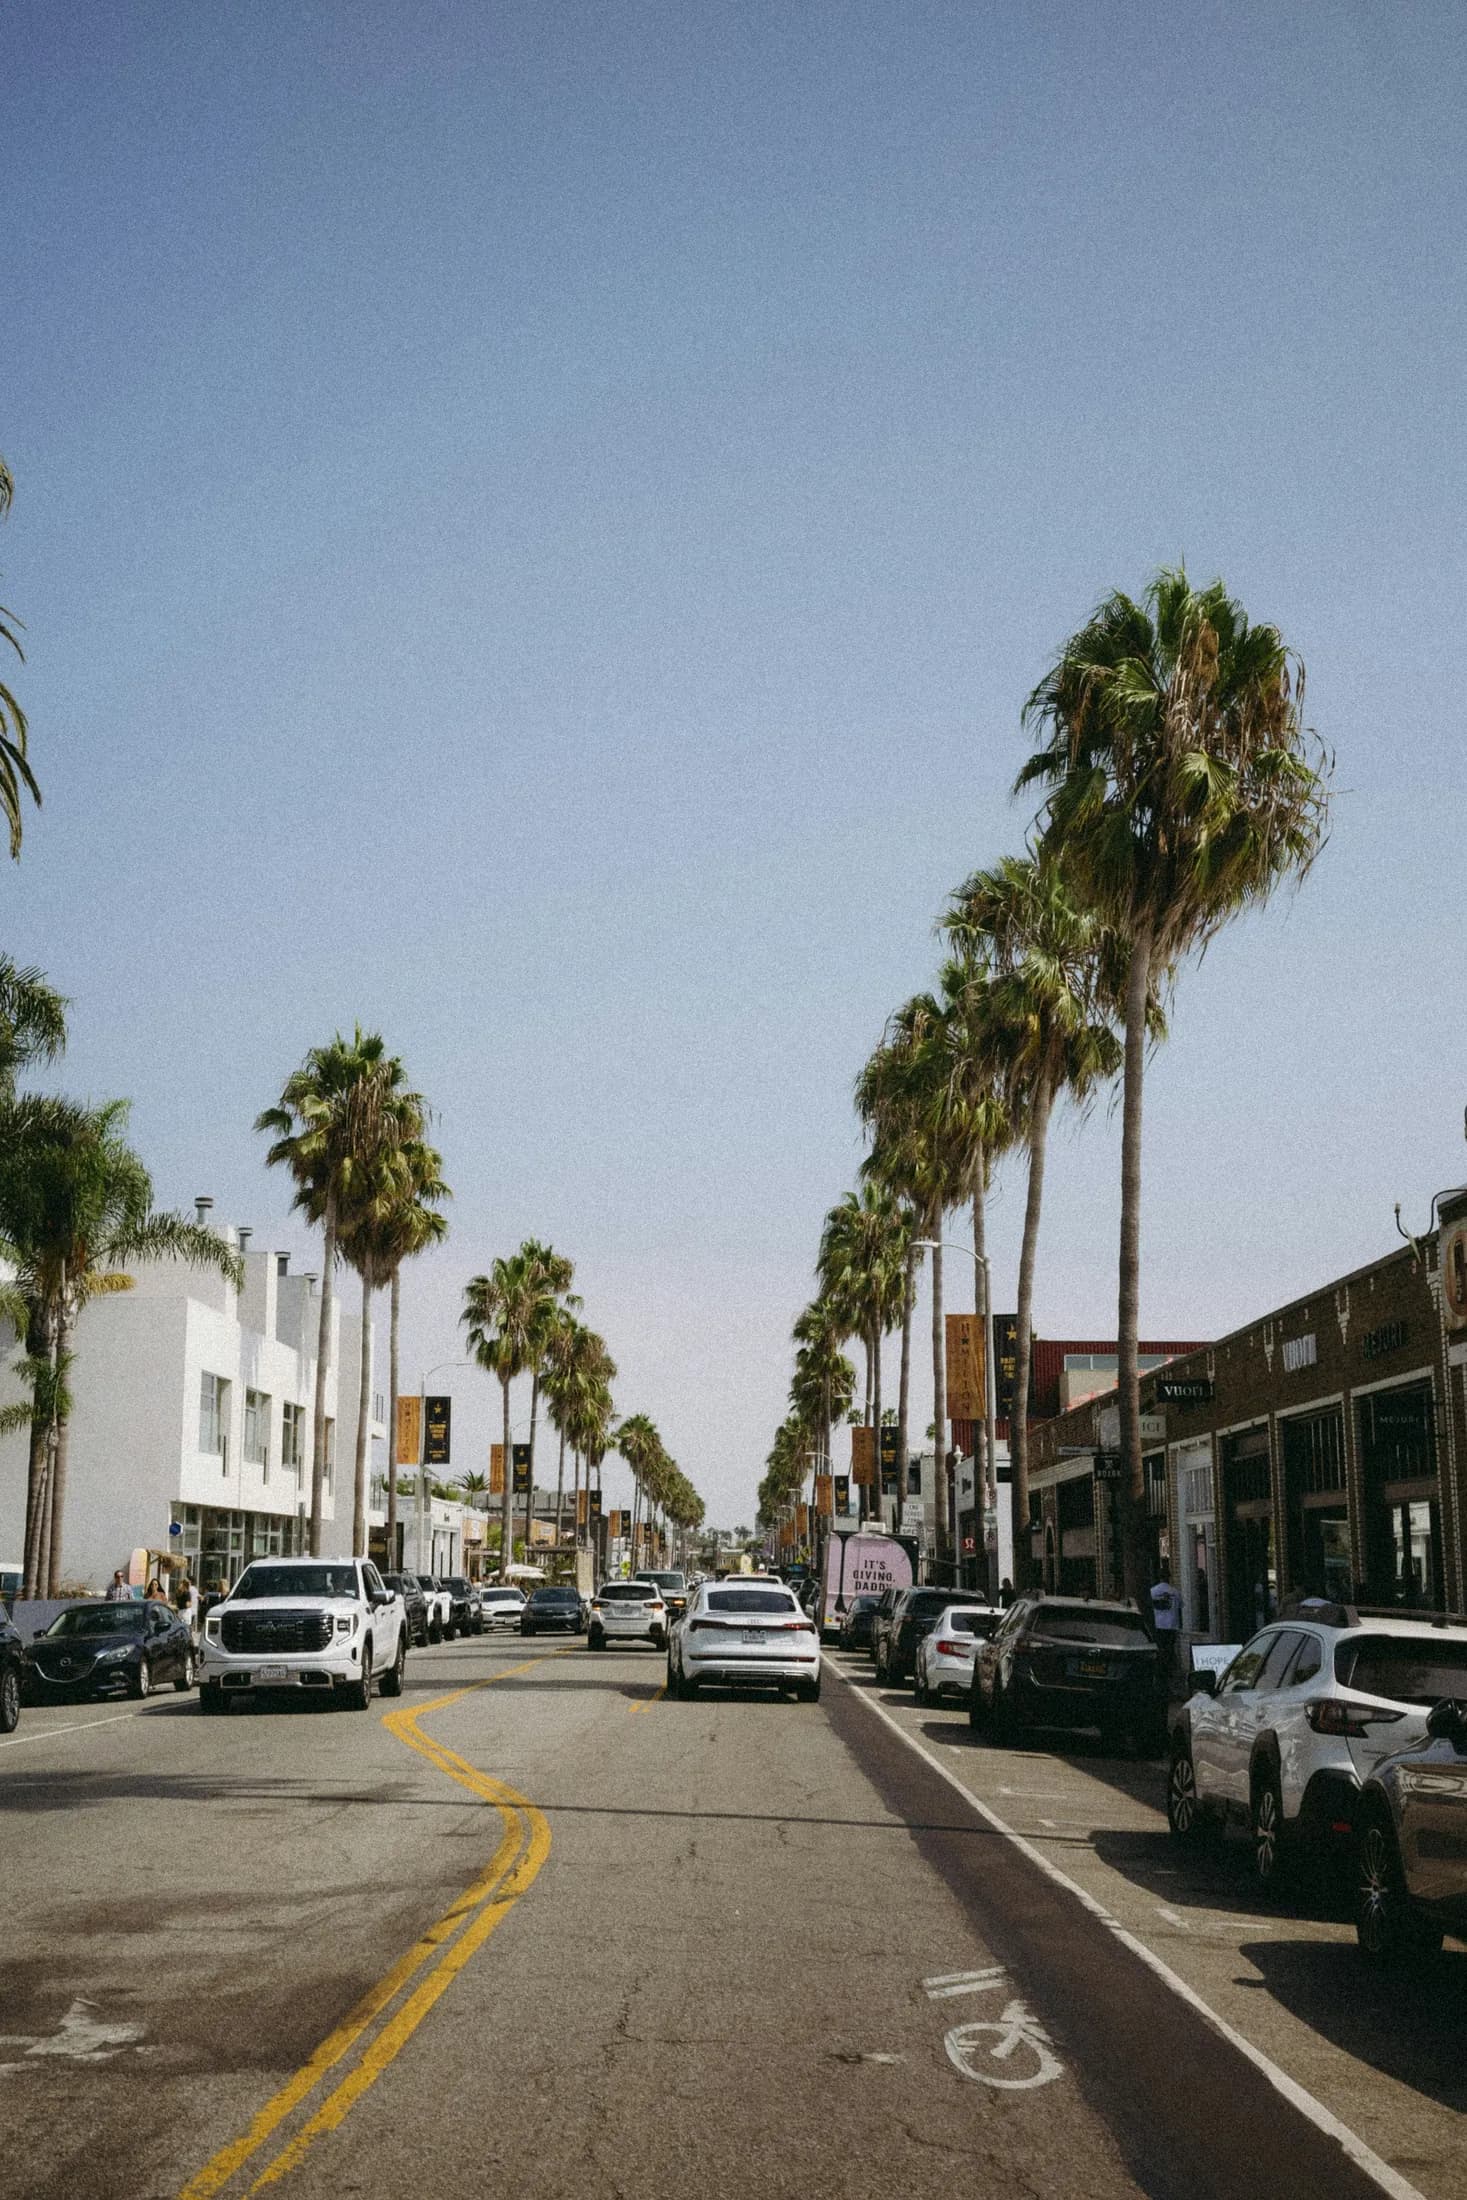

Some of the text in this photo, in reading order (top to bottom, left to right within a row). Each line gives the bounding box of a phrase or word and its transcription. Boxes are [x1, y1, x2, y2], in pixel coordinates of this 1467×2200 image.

[1164, 1385, 1203, 1396] vuori
[864, 1560, 886, 1570] IT'S
[853, 1570, 895, 1582] GIVING,
